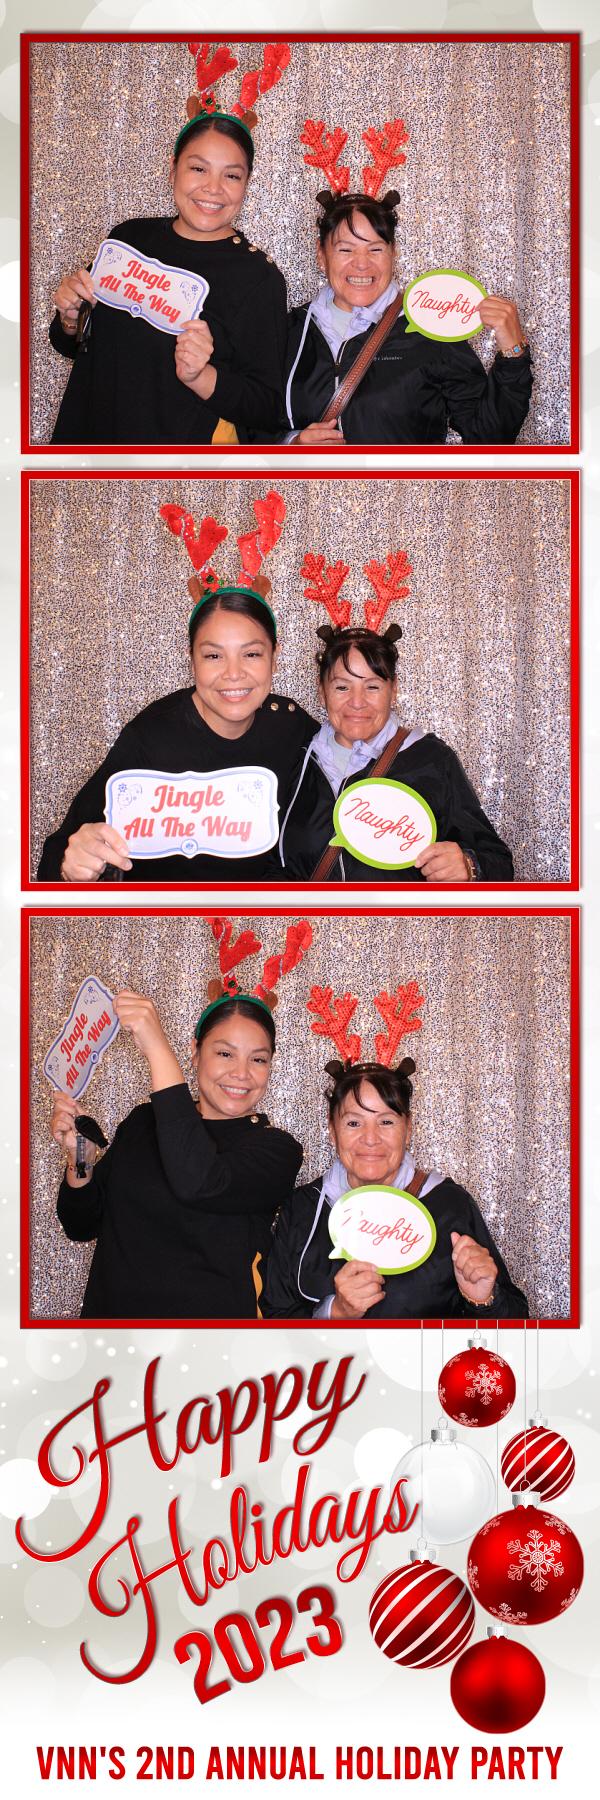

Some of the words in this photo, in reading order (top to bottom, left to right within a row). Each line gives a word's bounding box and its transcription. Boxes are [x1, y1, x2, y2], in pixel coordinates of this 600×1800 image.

[121, 260, 172, 292] Jingle
[99, 274, 122, 292] All
[123, 283, 146, 304] The
[148, 294, 181, 324] Way
[411, 290, 477, 325] Naughty
[150, 785, 226, 814] Jingle
[123, 816, 155, 840] All
[161, 816, 196, 838] The
[201, 815, 253, 842] Way
[344, 797, 425, 852] Naughty
[60, 1013, 88, 1062] Jingle
[66, 1064, 79, 1090] All
[75, 1044, 92, 1067] The
[87, 1010, 112, 1042] Way
